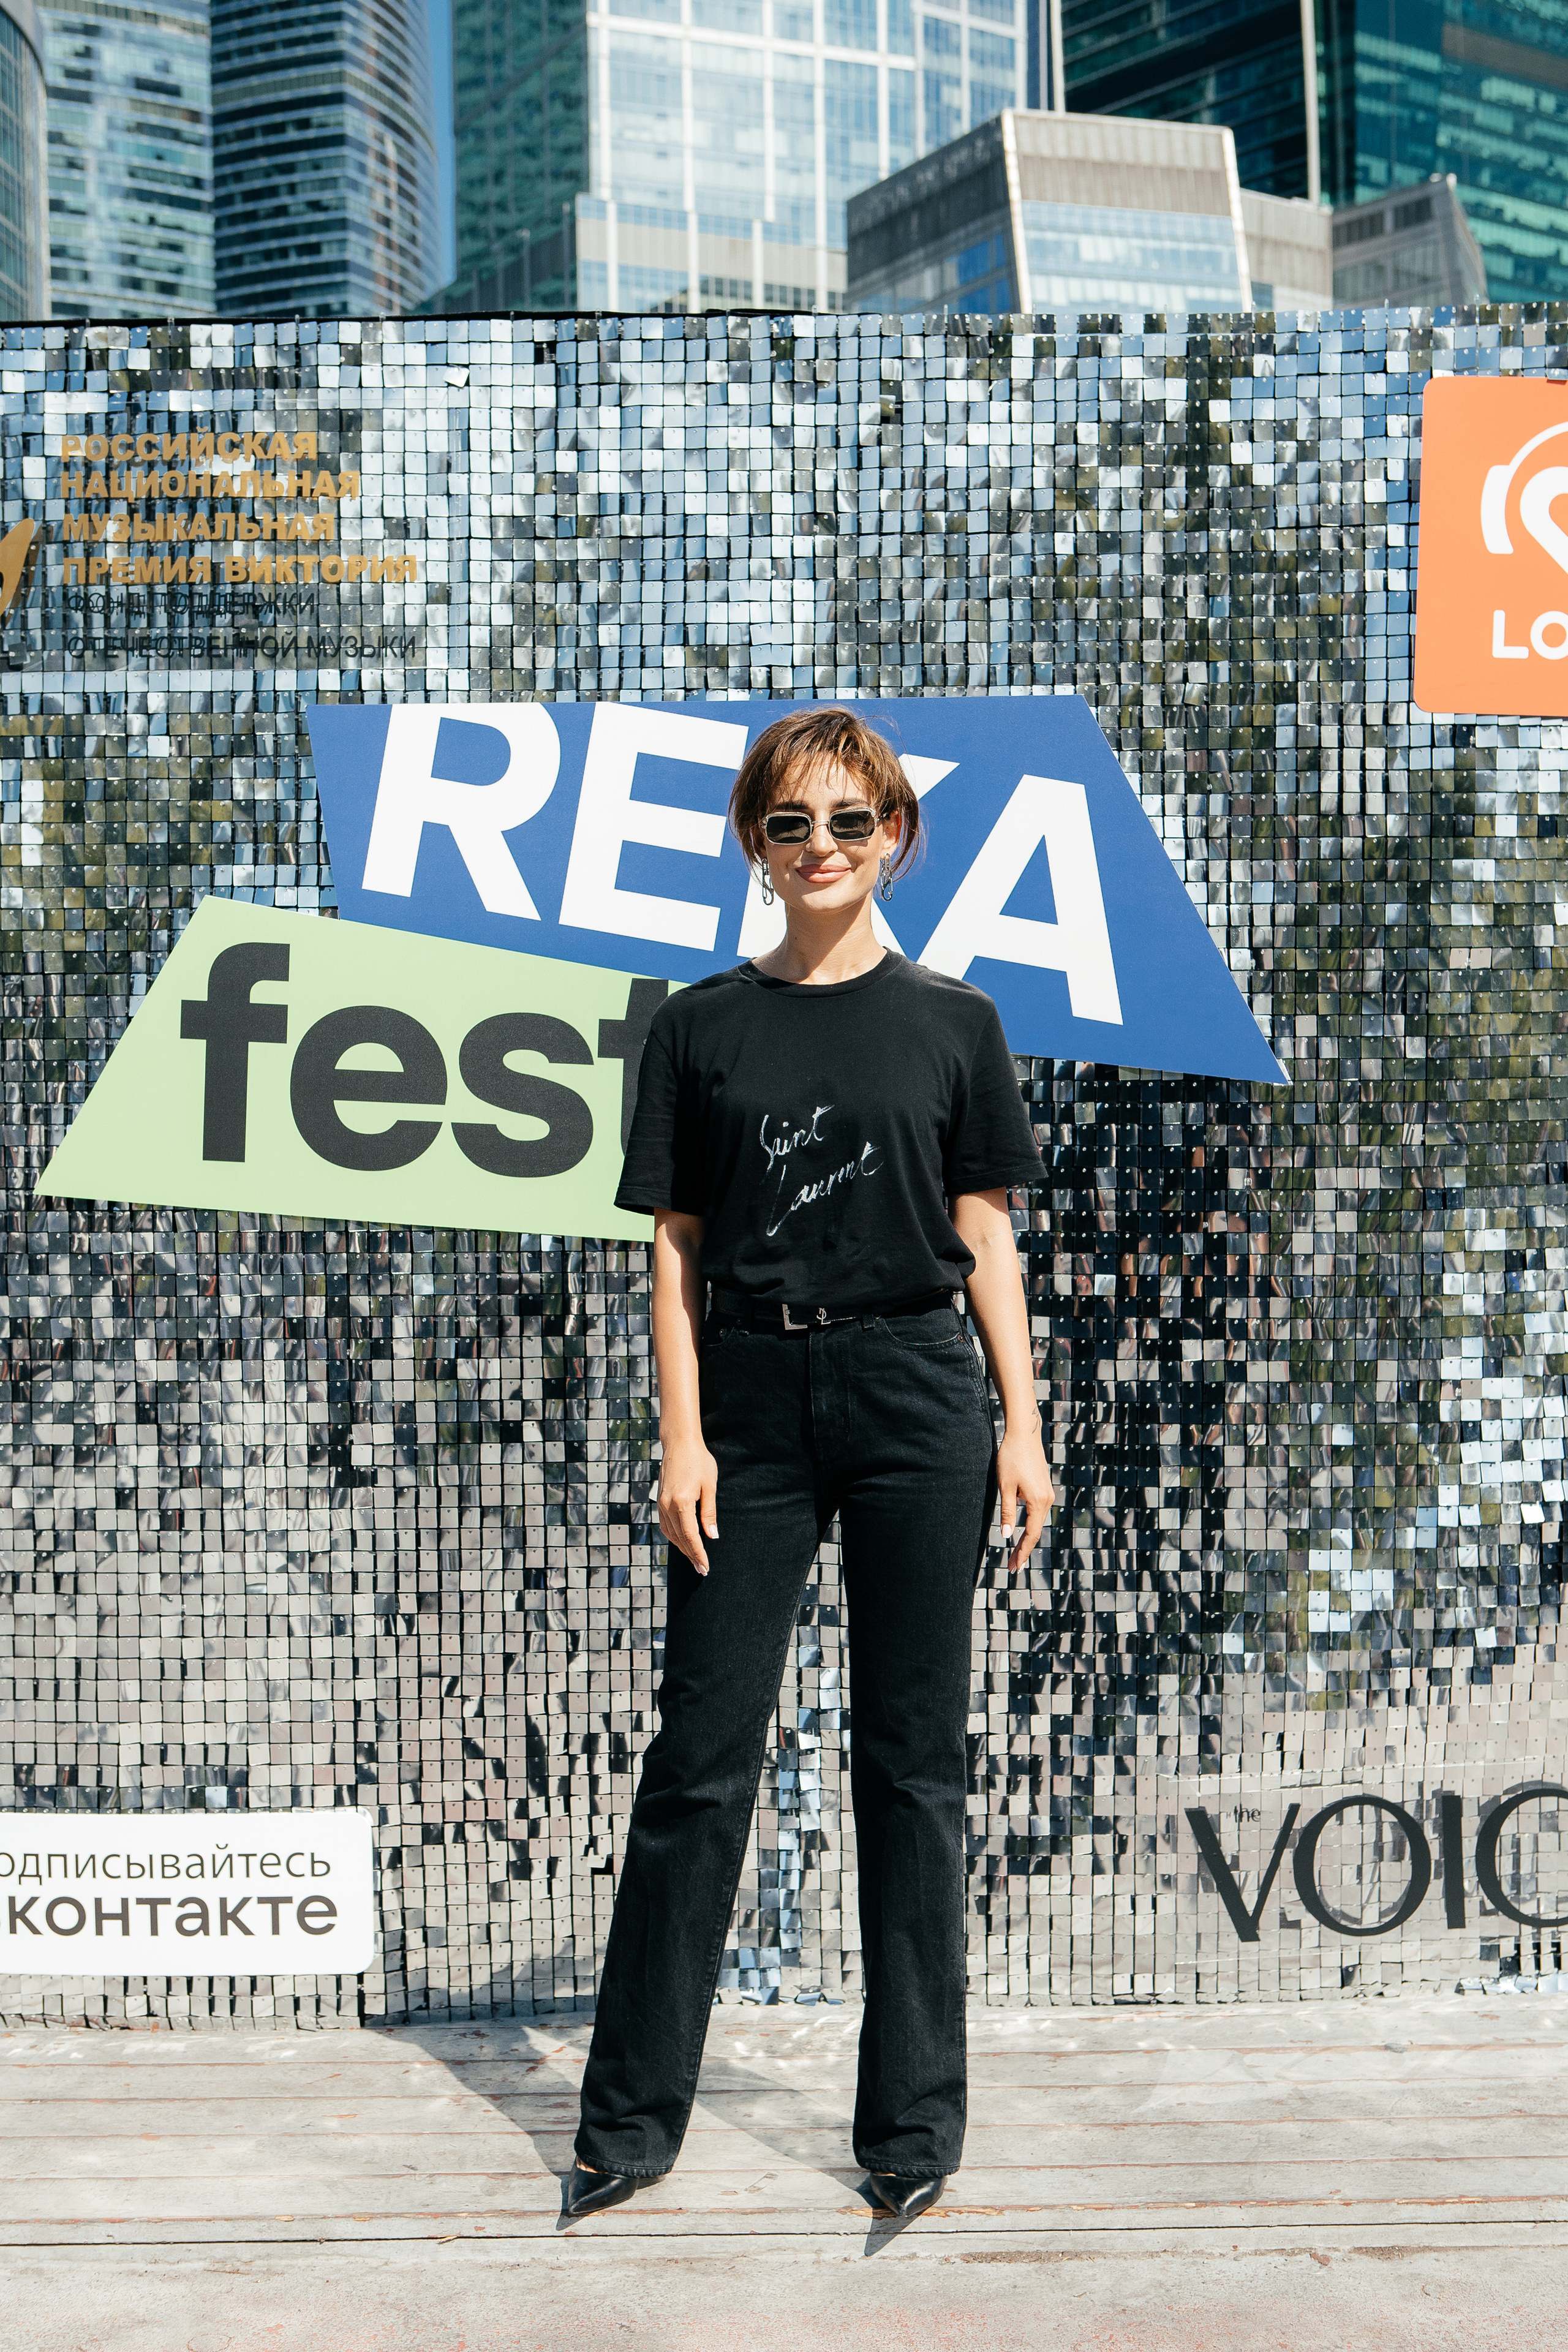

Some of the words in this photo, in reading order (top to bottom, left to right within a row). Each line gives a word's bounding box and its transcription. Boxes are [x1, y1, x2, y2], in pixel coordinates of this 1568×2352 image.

[61, 427, 317, 462] РОССИЙСКАЯ
[61, 470, 360, 501] НАЦИОНАЛЬНАЯ
[63, 513, 334, 541] МУЗЫКАЛЬНАЯ
[63, 556, 211, 584] ПРЕМИЯ
[224, 555, 417, 584] ВИКТОРИЯ
[68, 630, 298, 659] ОТЕЧЕСТВЕННОЙ
[306, 635, 417, 658] МУЗЫКИ
[361, 700, 1125, 1027] REA
[759, 1104, 835, 1185] Saint
[766, 1141, 884, 1237] Laurent
[1233, 1802, 1261, 1823] the
[0, 1843, 331, 1885] одписывайтесь
